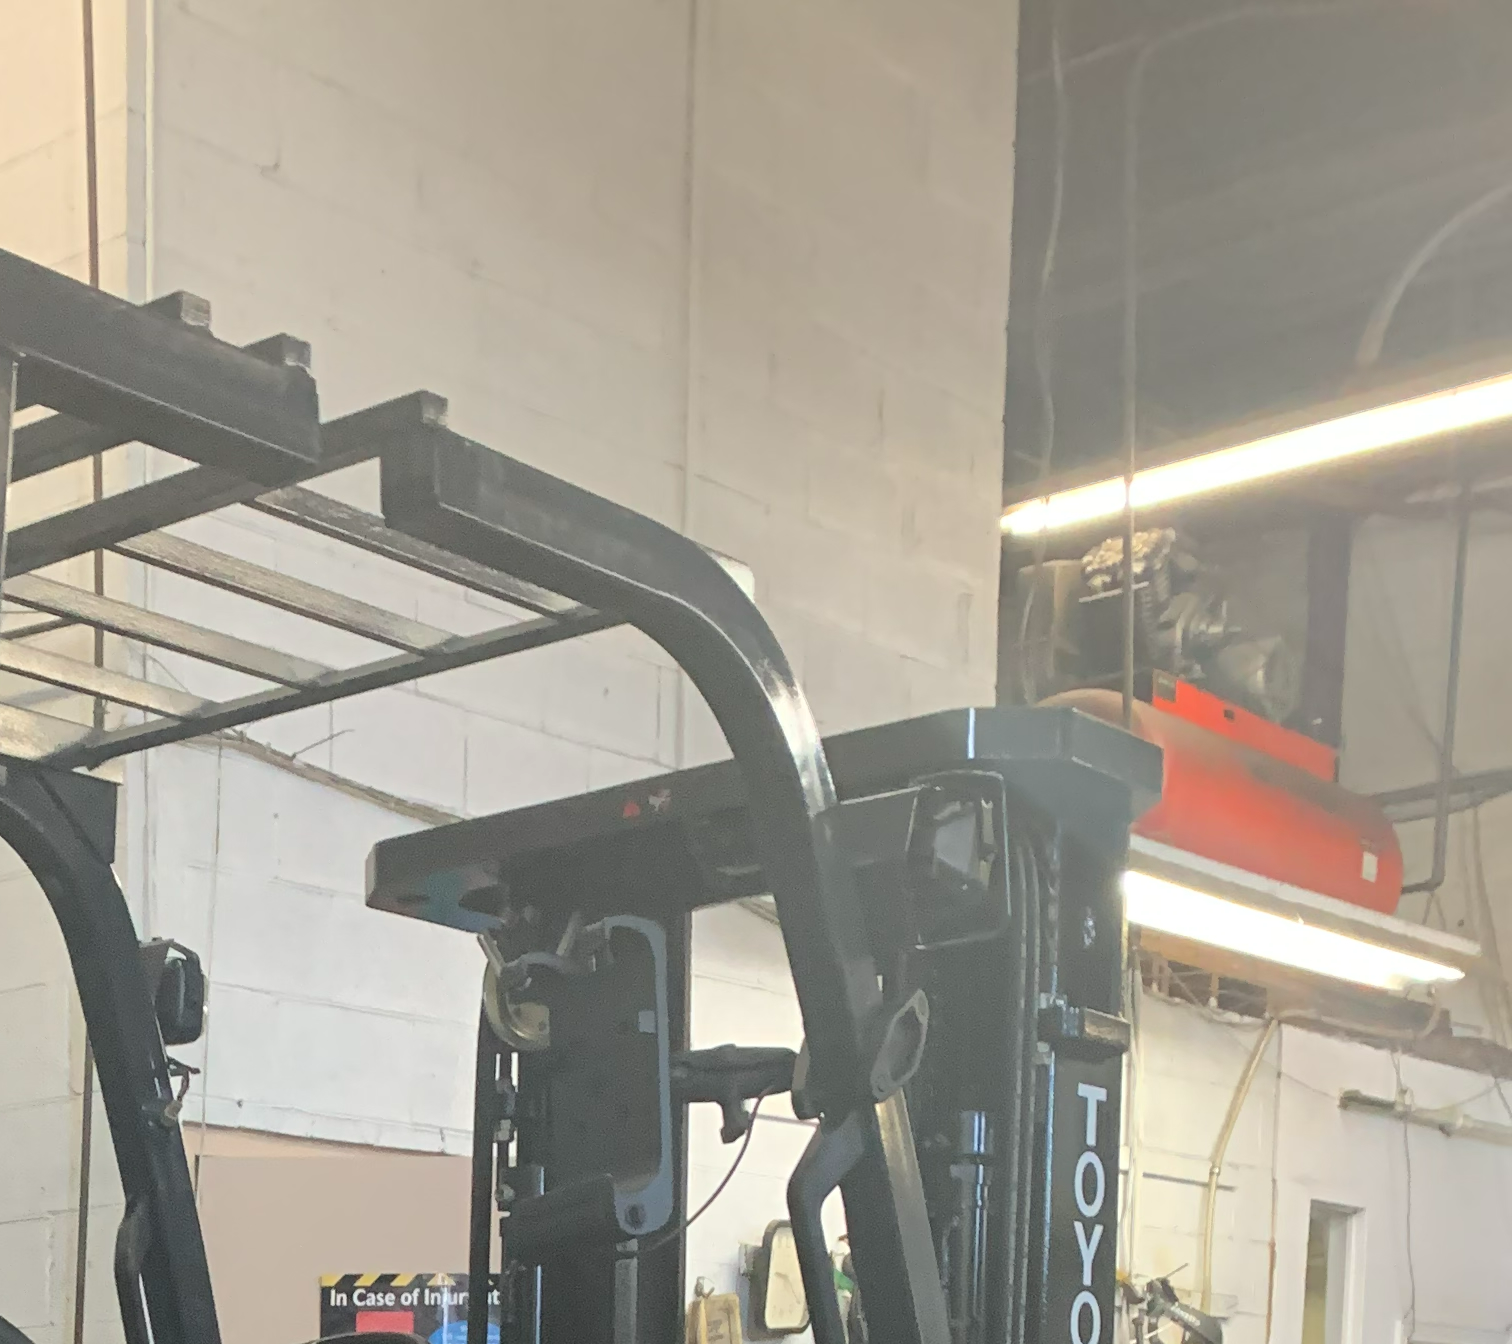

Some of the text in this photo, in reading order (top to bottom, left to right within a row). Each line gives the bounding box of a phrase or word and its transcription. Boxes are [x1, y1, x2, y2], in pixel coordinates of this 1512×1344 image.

[330, 1288, 348, 1307] In
[352, 1288, 396, 1307] Case
[400, 1288, 421, 1307] of
[424, 1289, 469, 1310] Injur
